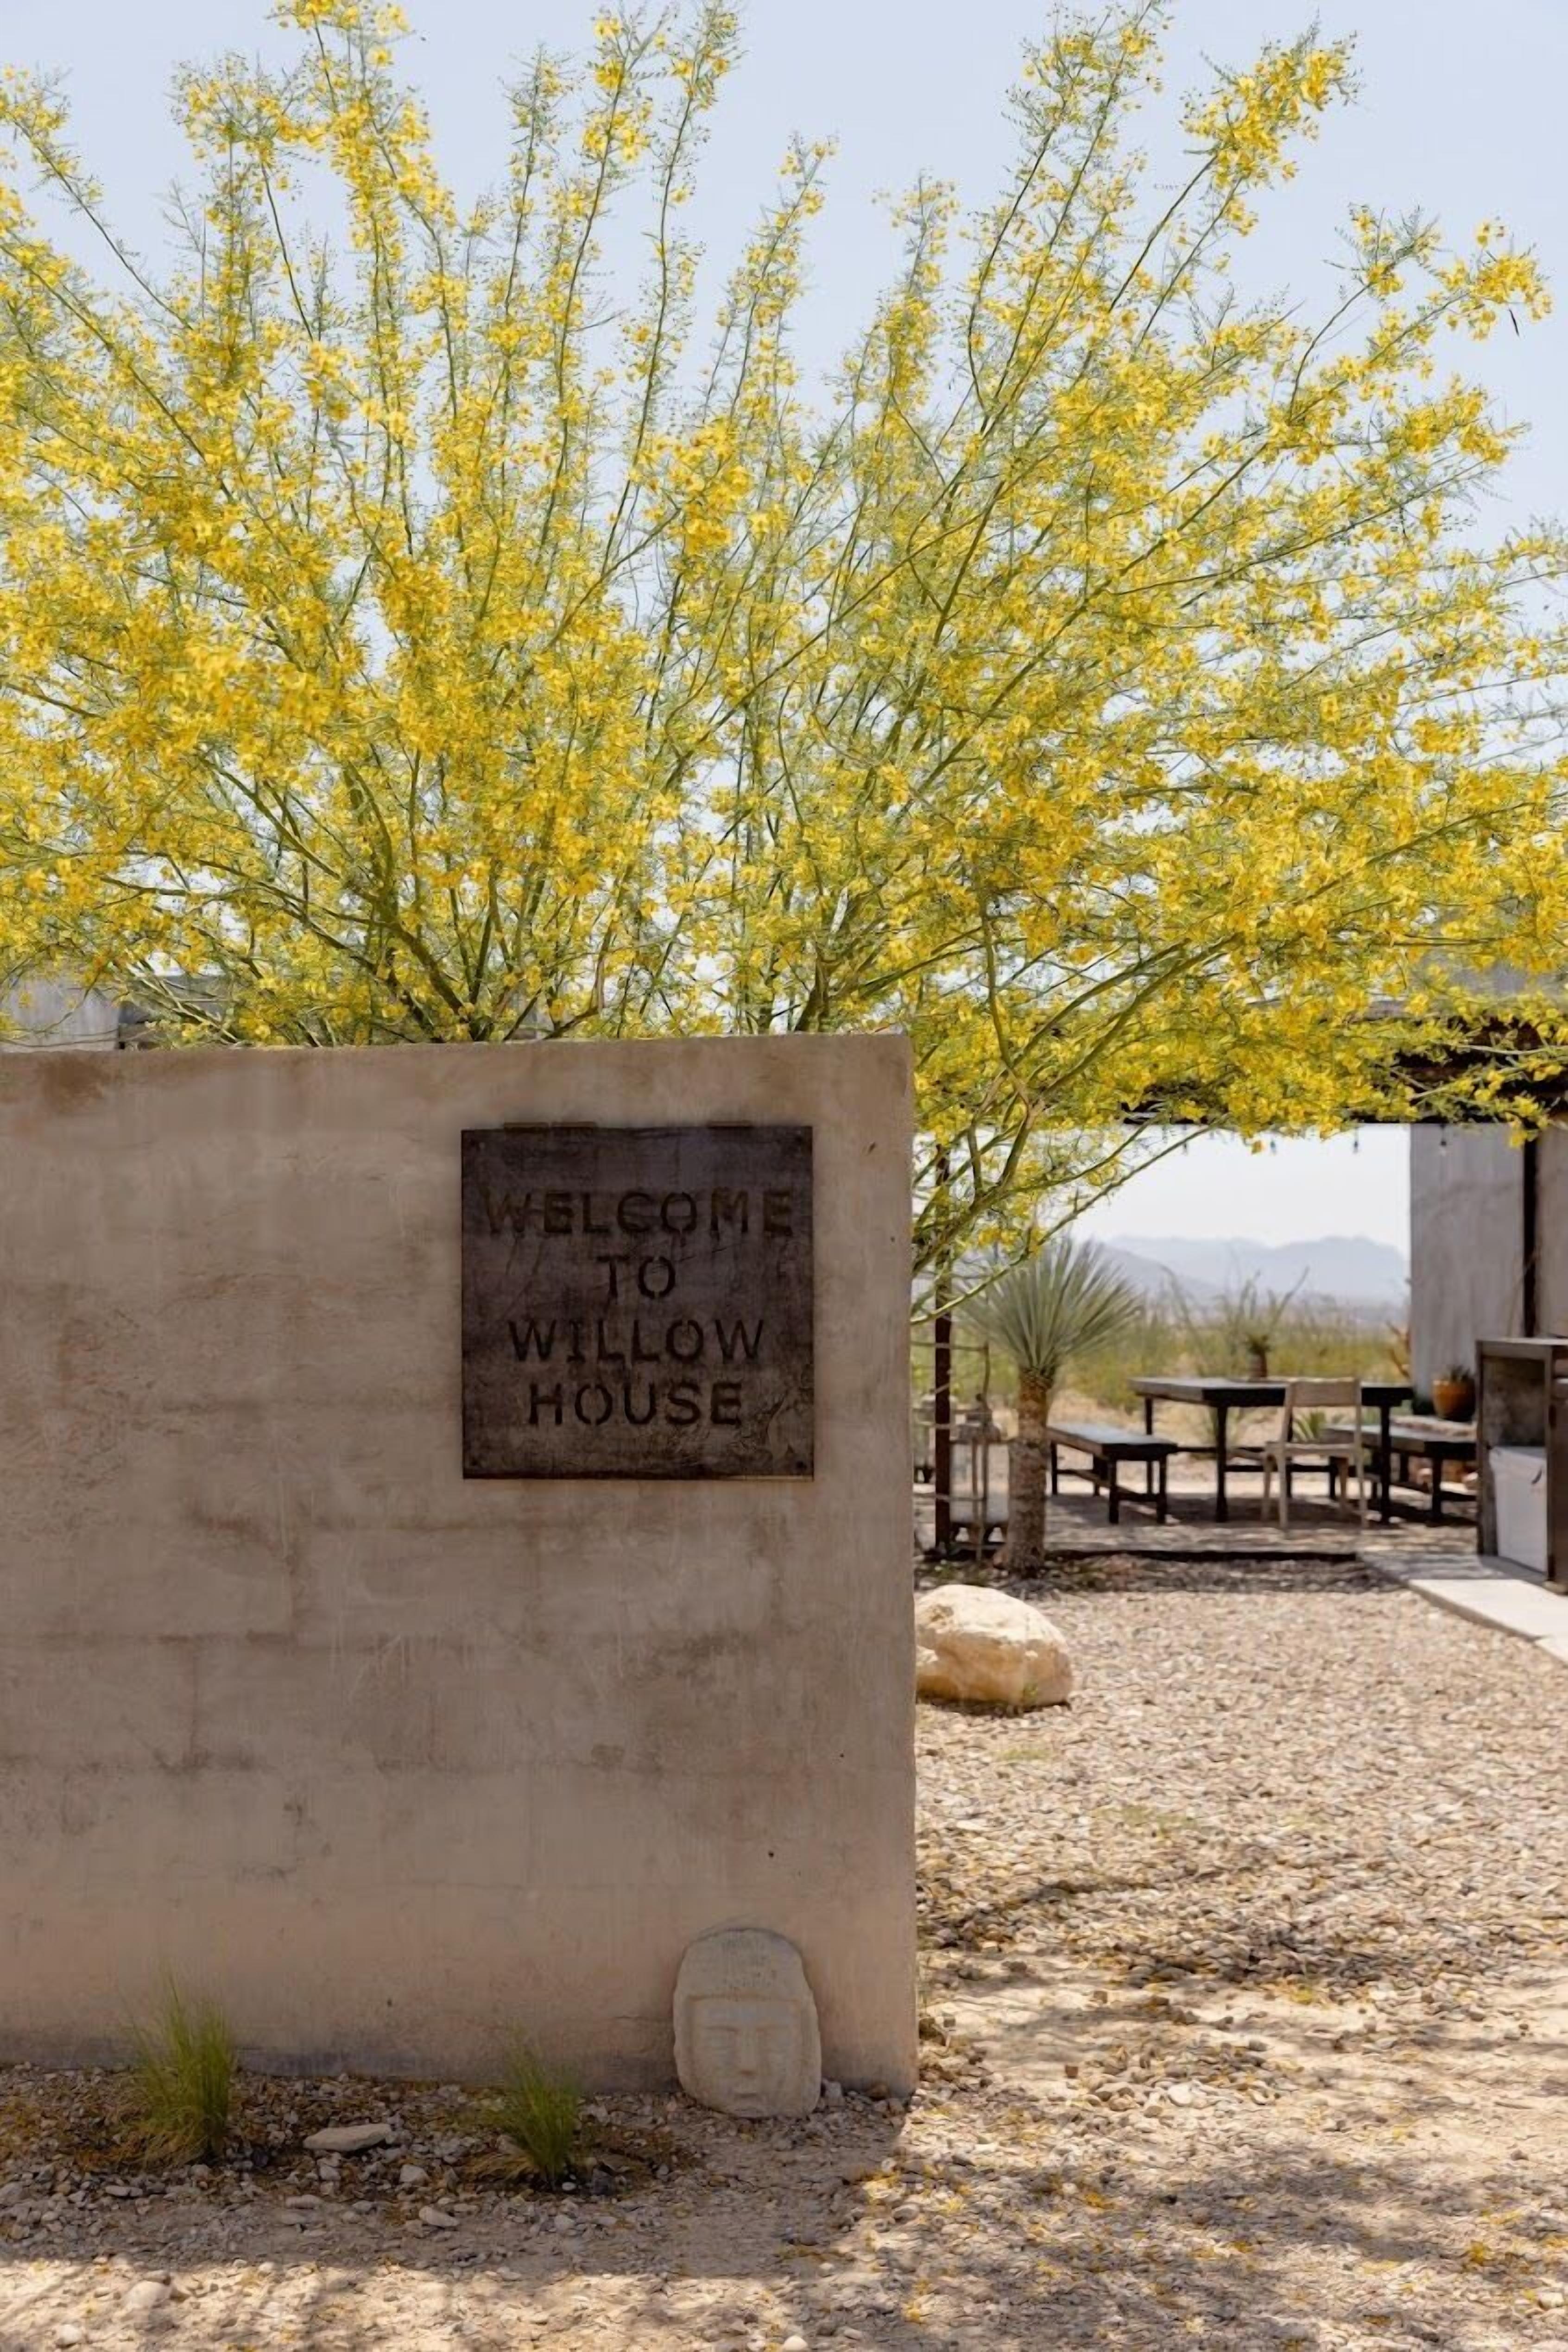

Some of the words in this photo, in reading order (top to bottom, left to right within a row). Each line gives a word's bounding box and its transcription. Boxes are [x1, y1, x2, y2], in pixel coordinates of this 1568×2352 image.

[483, 1189, 793, 1236] WELCOME
[596, 1255, 675, 1297] TO
[508, 1319, 764, 1362] WILLOW
[528, 1382, 741, 1425] HOUSE
